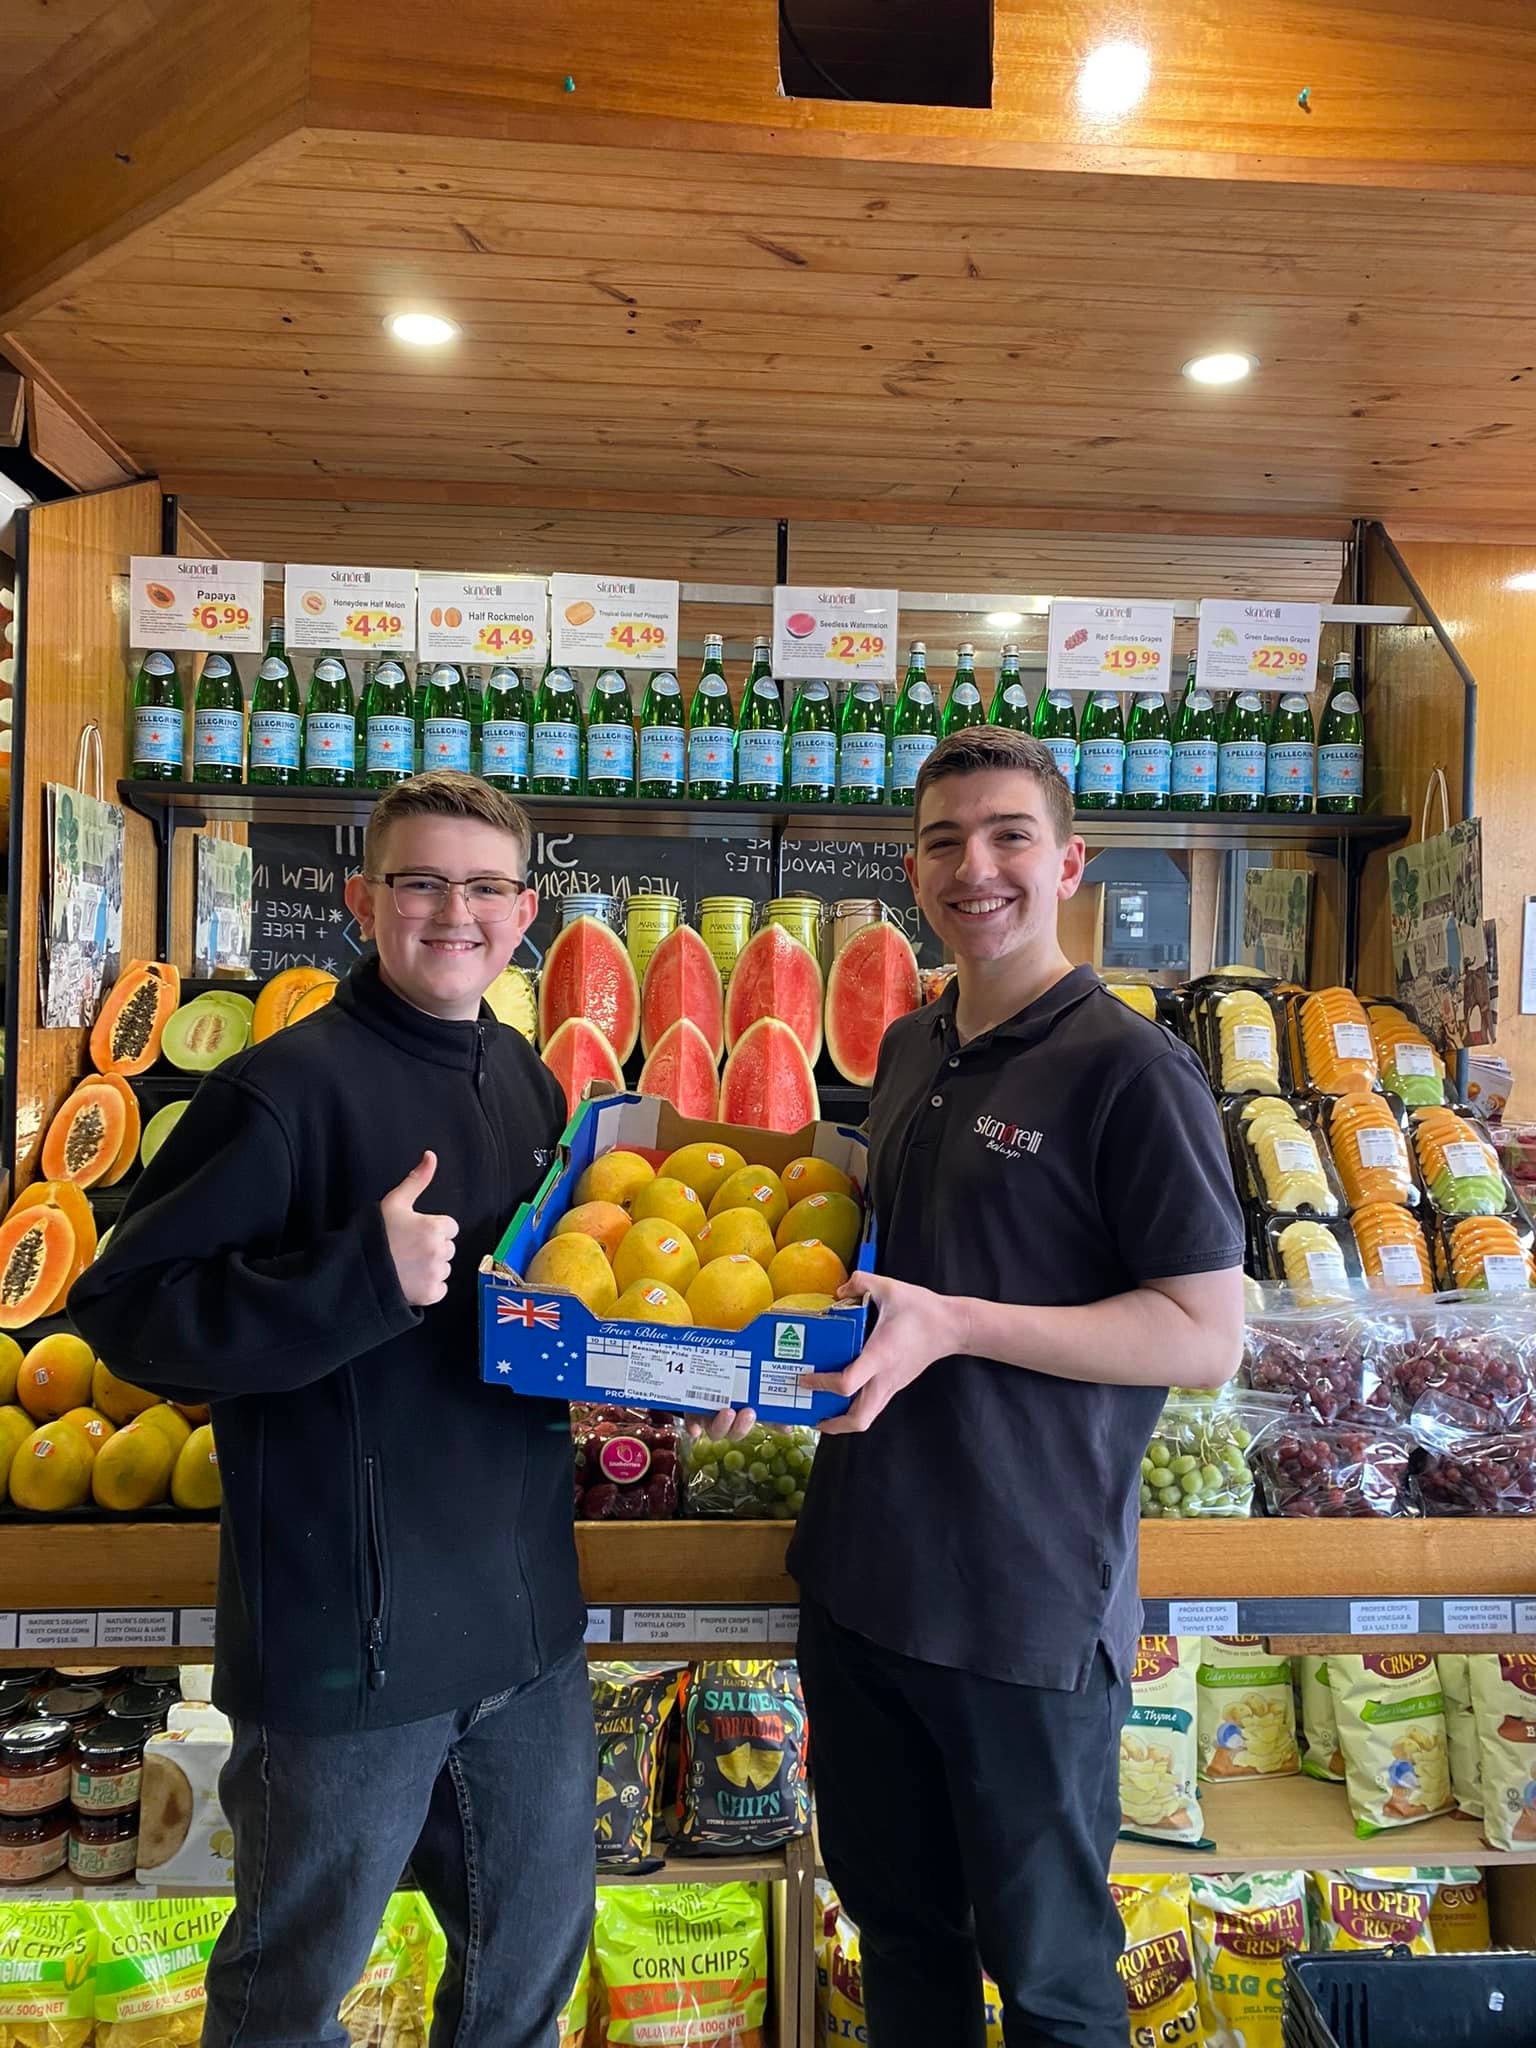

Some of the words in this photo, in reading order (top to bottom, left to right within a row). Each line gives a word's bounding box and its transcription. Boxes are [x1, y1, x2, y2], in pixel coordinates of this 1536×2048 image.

[197, 590, 236, 602] Papaya
[333, 598, 368, 609] Honeydew
[370, 600, 383, 608] Half
[385, 600, 406, 609] Melon
[192, 606, 249, 629] $6.99
[345, 614, 401, 637] $4.49
[468, 611, 484, 621] Half
[487, 612, 534, 623] Rockmelon
[820, 620, 848, 628] Seedless
[850, 621, 888, 629] Watermelon
[479, 627, 534, 650] $4.49
[611, 626, 665, 648] $4.49
[1096, 633, 1108, 641] Red
[1109, 634, 1138, 642] Seedless
[1140, 635, 1163, 644] Grapes
[1245, 633, 1261, 641] Green
[1263, 634, 1288, 642] Seedless
[1289, 635, 1311, 644] Grapes
[831, 636, 884, 658] $2.49
[1104, 650, 1161, 669] $19.99
[1252, 650, 1307, 669] $22.99
[599, 1322, 631, 1337] True
[634, 1326, 669, 1341] Blue
[673, 1330, 736, 1347] Mangoes
[632, 1345, 670, 1356] Kensington
[671, 1350, 689, 1358] Pride
[665, 1360, 685, 1375] 14
[771, 1363, 804, 1372] VARIETY
[1132, 1709, 1141, 1720] &
[1145, 1708, 1178, 1725] Thyme
[717, 1790, 780, 1817] CHIPS
[1337, 1885, 1423, 1922] PROPER
[112, 1927, 168, 1956] CORN
[632, 1956, 685, 1979] CORN
[692, 1947, 750, 1975] CHIPS
[1210, 1971, 1261, 1997] BIG
[16, 2002, 44, 2017] 500g
[45, 2001, 65, 2014] NET
